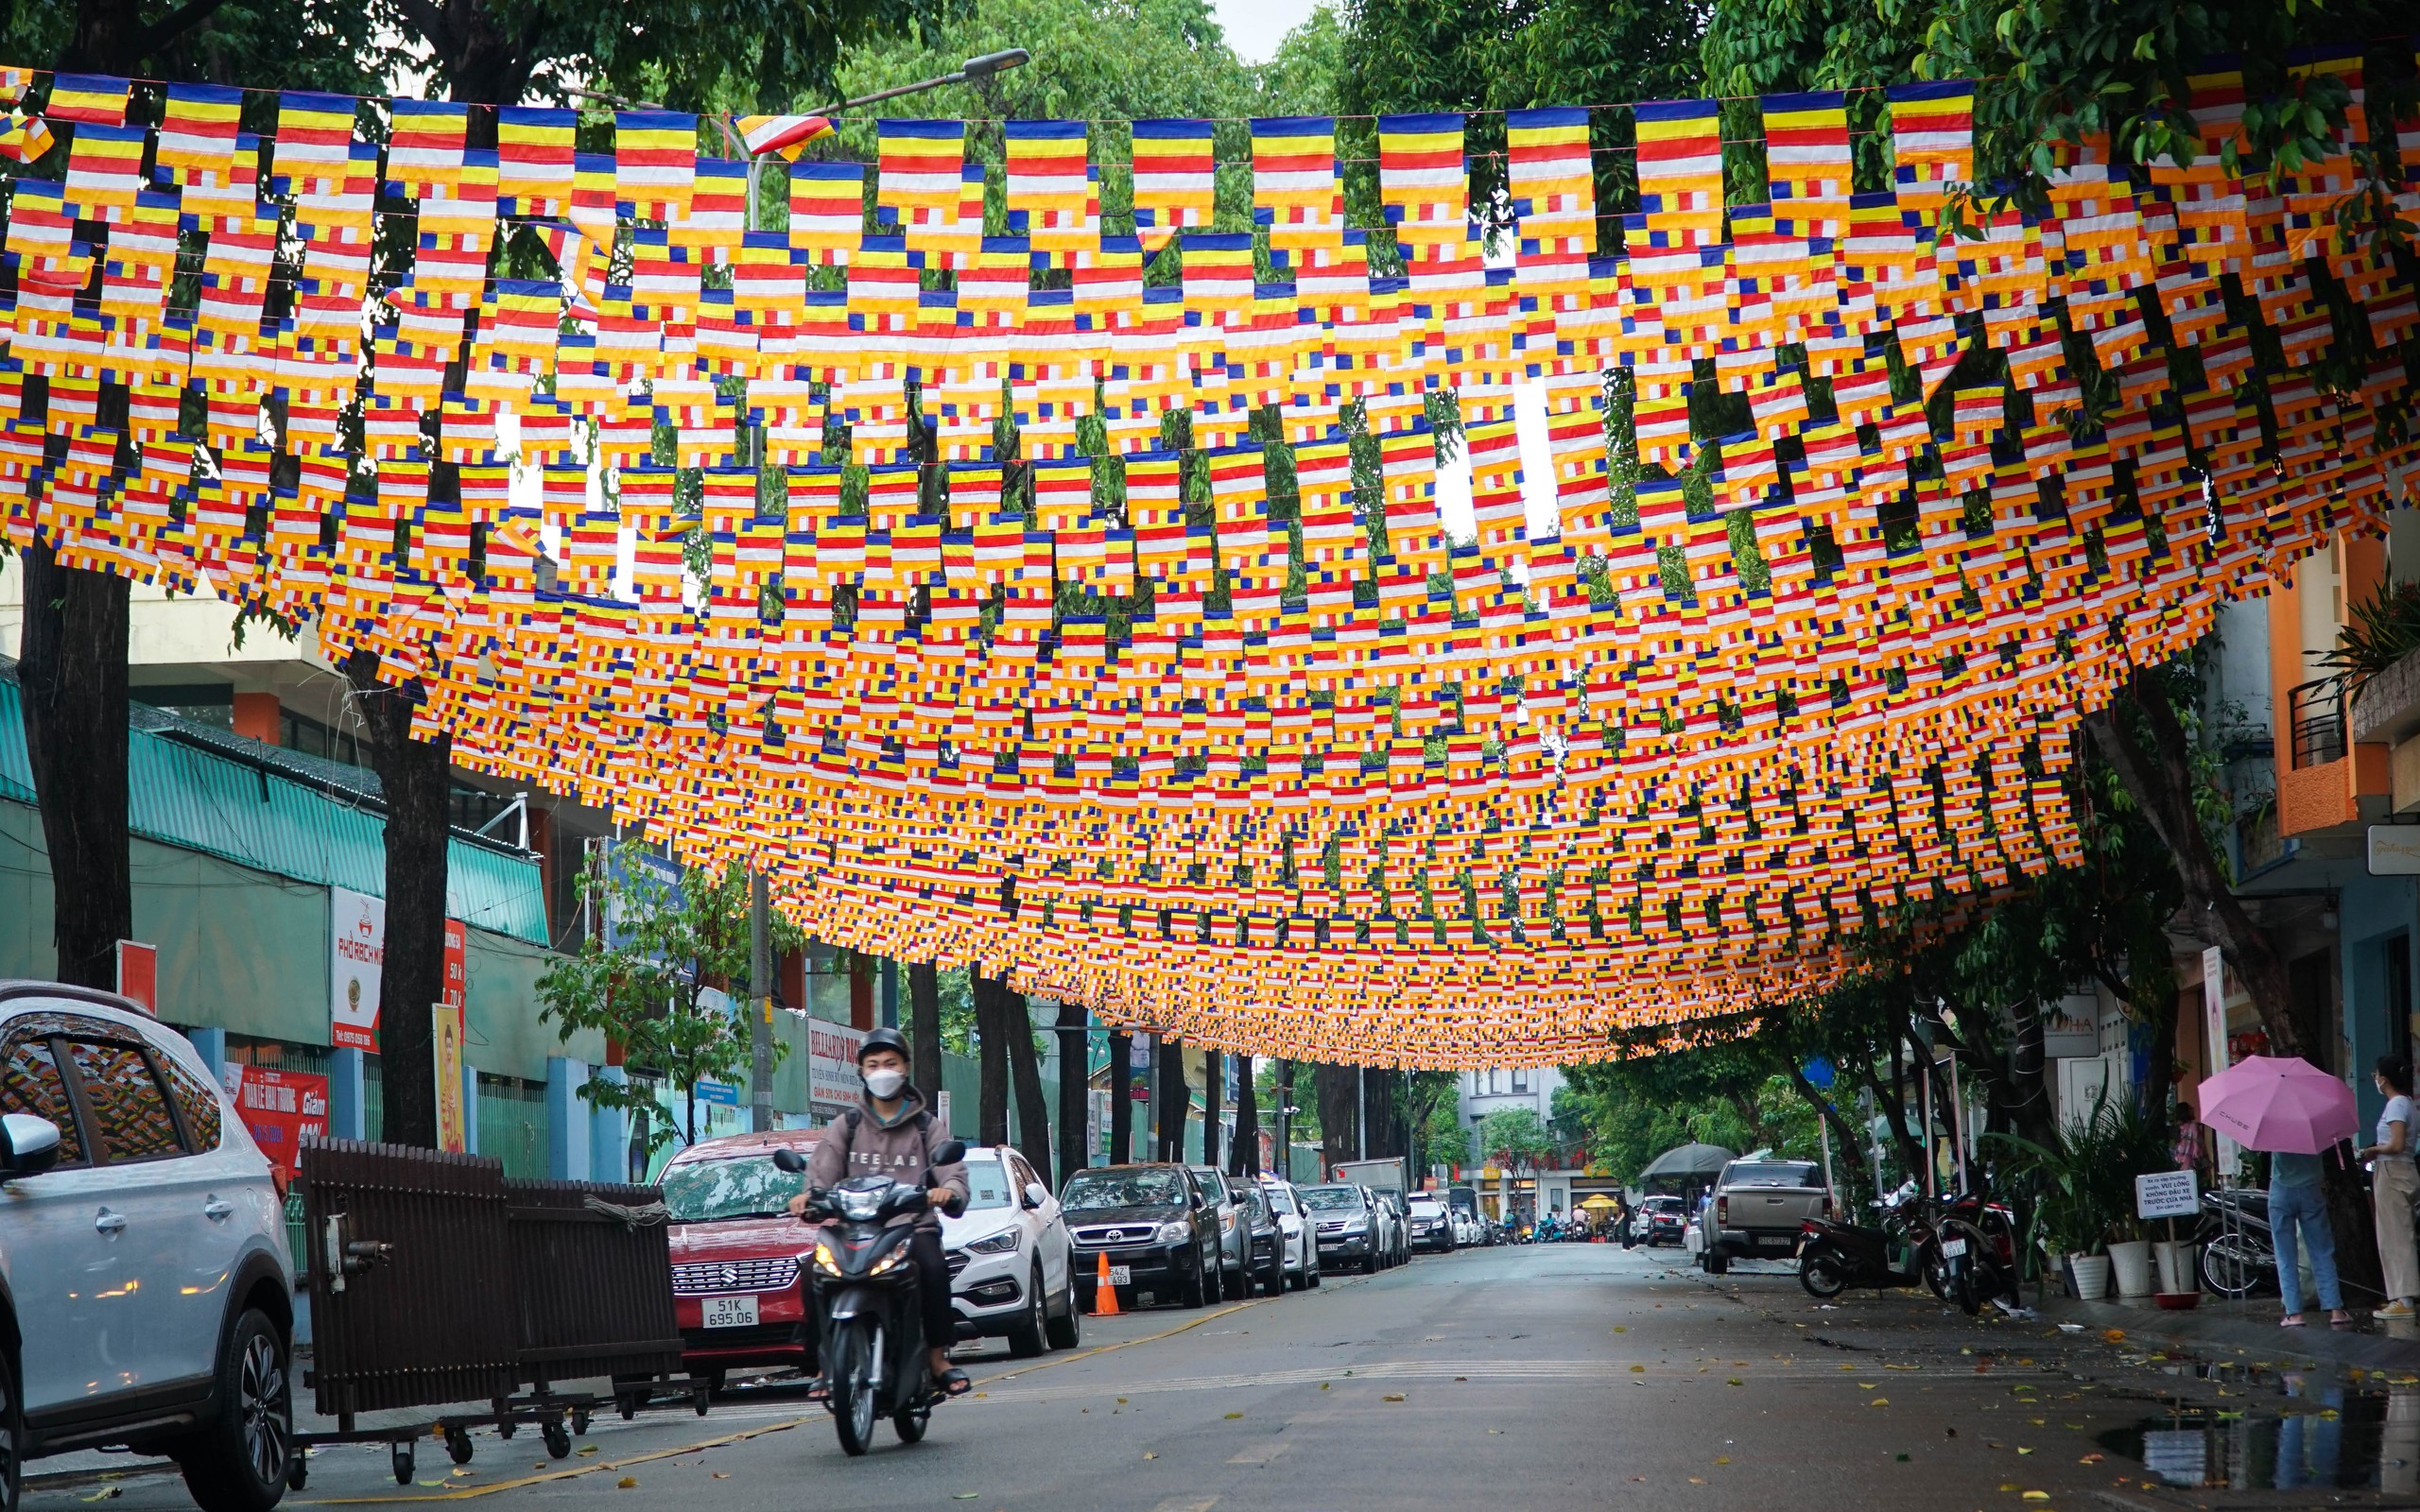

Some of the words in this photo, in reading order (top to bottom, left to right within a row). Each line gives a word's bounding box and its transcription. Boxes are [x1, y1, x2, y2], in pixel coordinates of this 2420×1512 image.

[449, 962, 458, 980] 50
[449, 988, 458, 1005] 70
[810, 1030, 845, 1061] BILLIARDS
[302, 1090, 326, 1116] Giảm
[849, 1151, 918, 1167] TEELAB
[2166, 1195, 2179, 1204] CỬA
[1112, 1276, 1128, 1284] 493
[718, 1298, 742, 1312] 51K
[709, 1312, 752, 1326] 695.06
